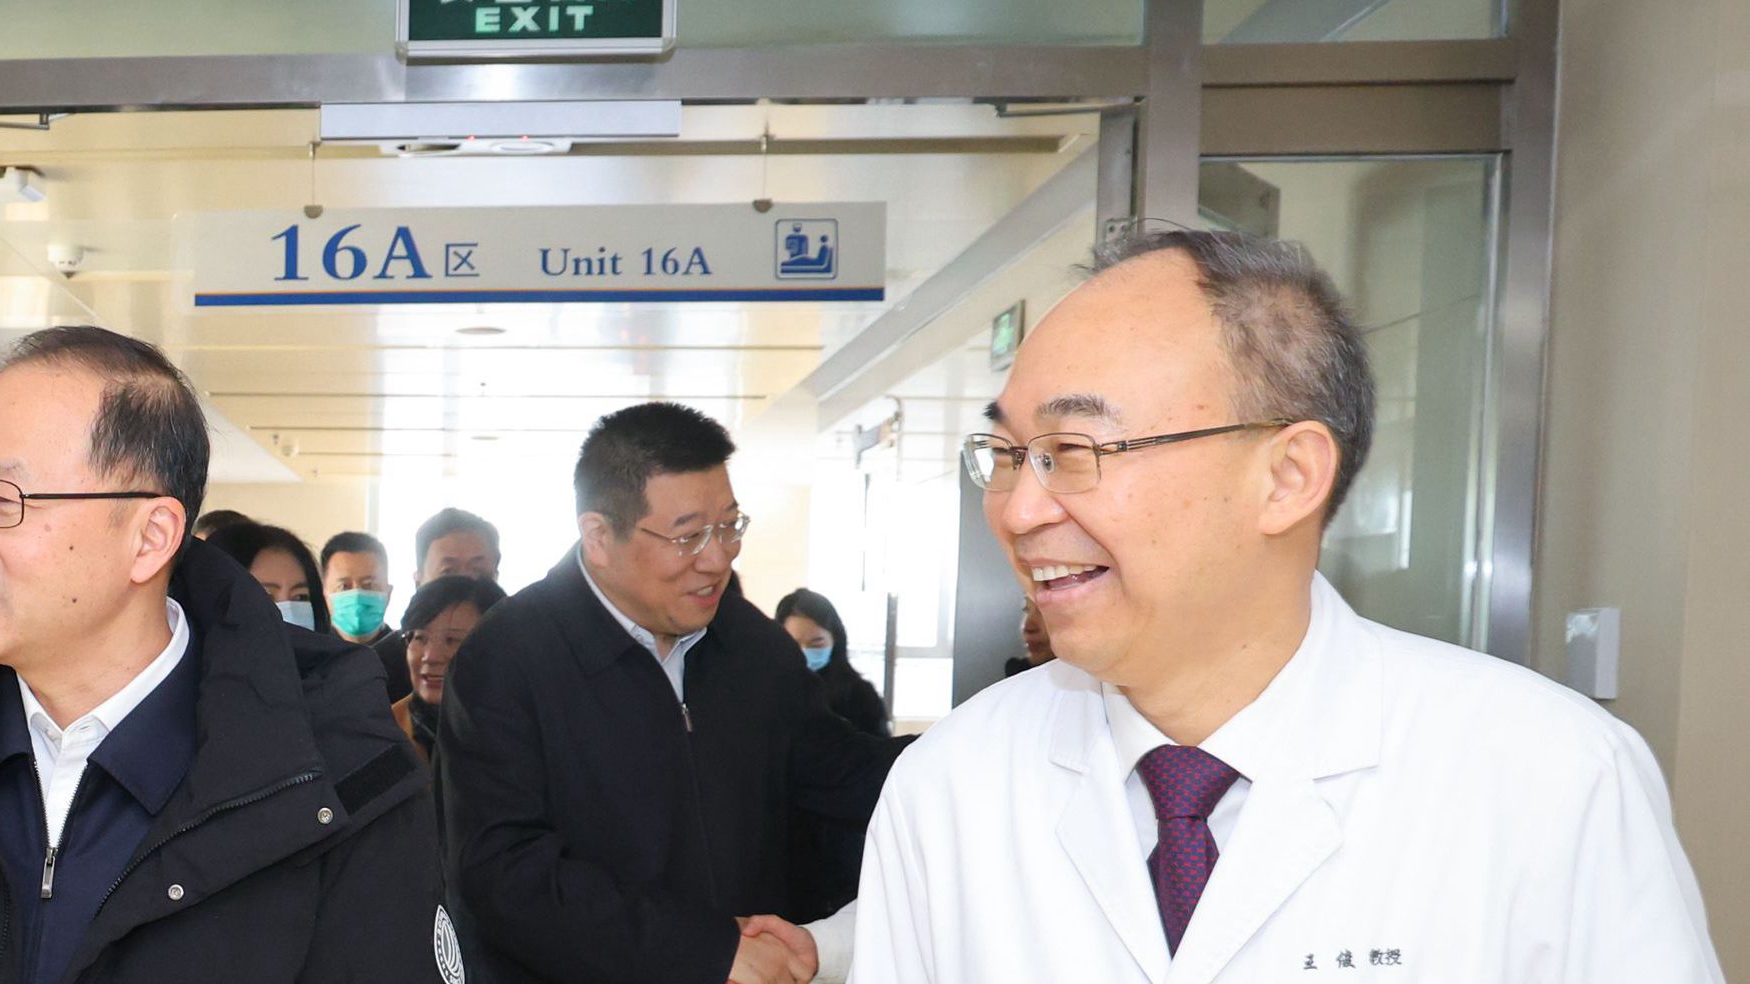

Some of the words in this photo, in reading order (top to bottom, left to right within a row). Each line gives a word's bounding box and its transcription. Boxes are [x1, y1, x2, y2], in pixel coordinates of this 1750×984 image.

[475, 6, 594, 32] EXIT
[538, 247, 623, 277] Unit
[641, 246, 713, 276] 16A
